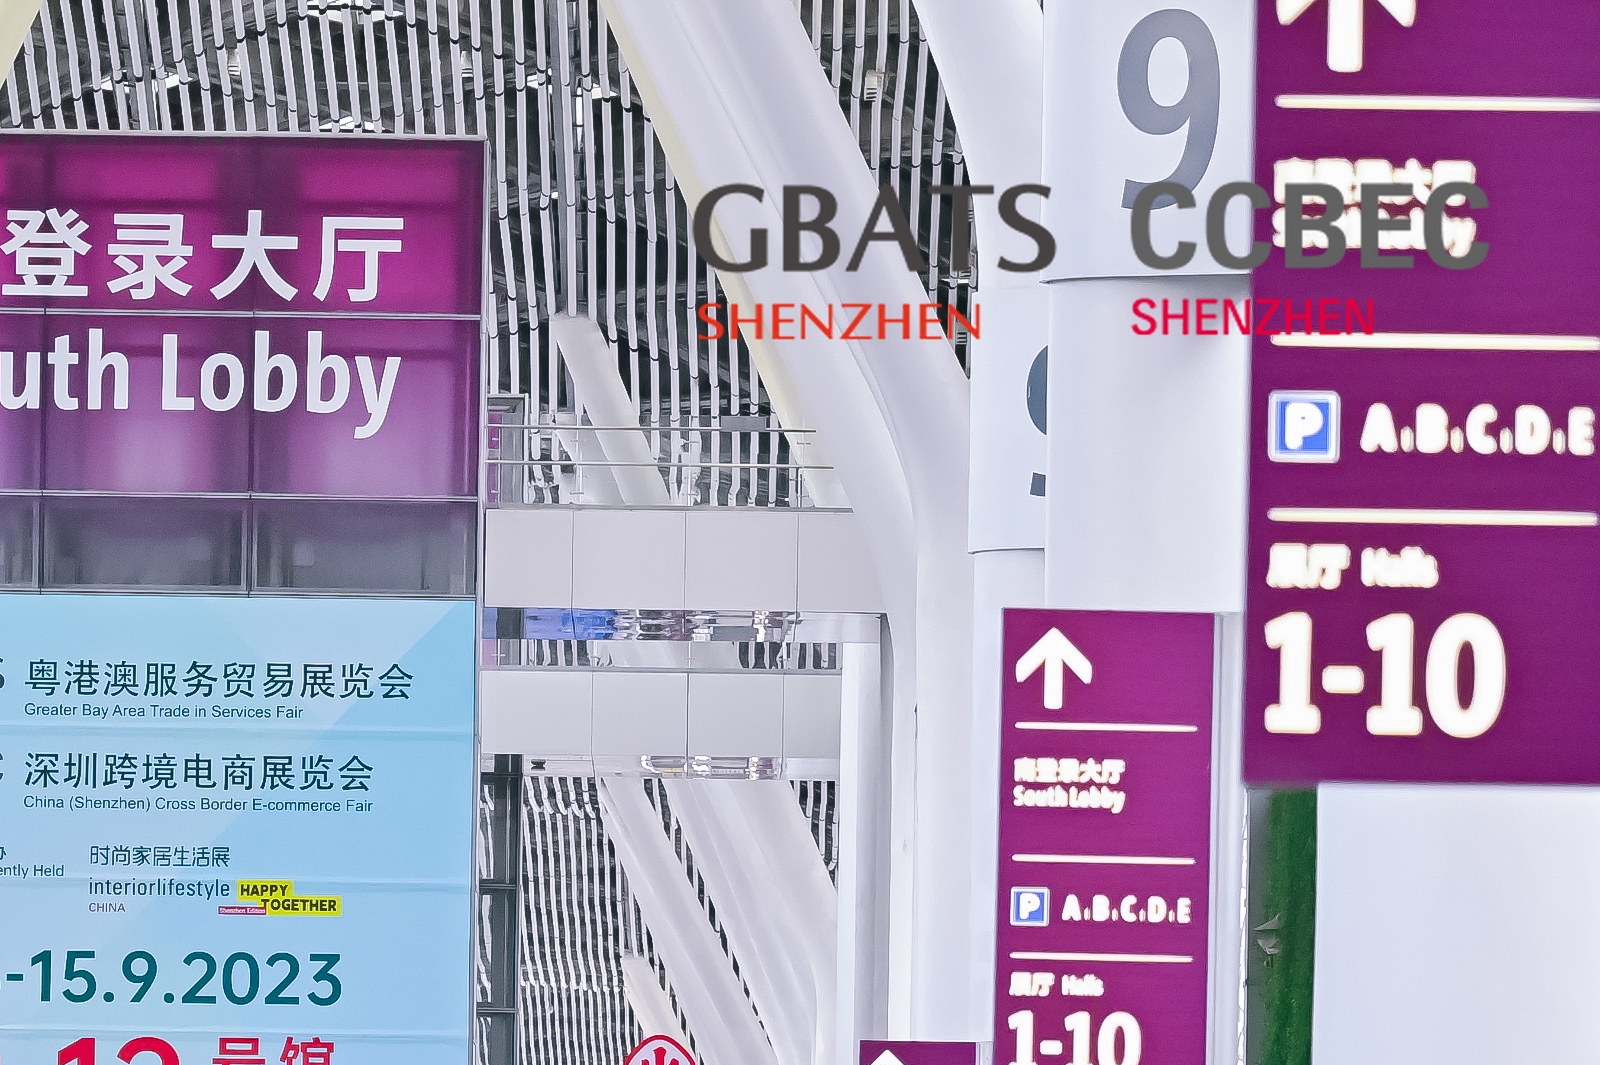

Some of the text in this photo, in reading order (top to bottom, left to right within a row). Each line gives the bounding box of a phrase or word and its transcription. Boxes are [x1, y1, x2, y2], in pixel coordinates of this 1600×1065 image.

[1116, 6, 1221, 213] 9
[161, 330, 402, 439] Lobby
[24, 658, 414, 700] 粤港澳服务贸易展览会
[1264, 610, 1508, 739] 1-10
[24, 702, 304, 720] Greater Bay Area Trade in Services Fair
[24, 752, 374, 792] 深圳跨境电商展览会
[23, 795, 374, 813] China (Shenzhen) Cross Border E-commerce Fair
[89, 845, 231, 868] 时尚家居生活展
[33, 863, 65, 878] Held
[88, 877, 230, 901] interiorlifestyle
[240, 884, 289, 897] HAPPY
[88, 902, 126, 914] CHINA
[260, 898, 338, 913] TOGETHER
